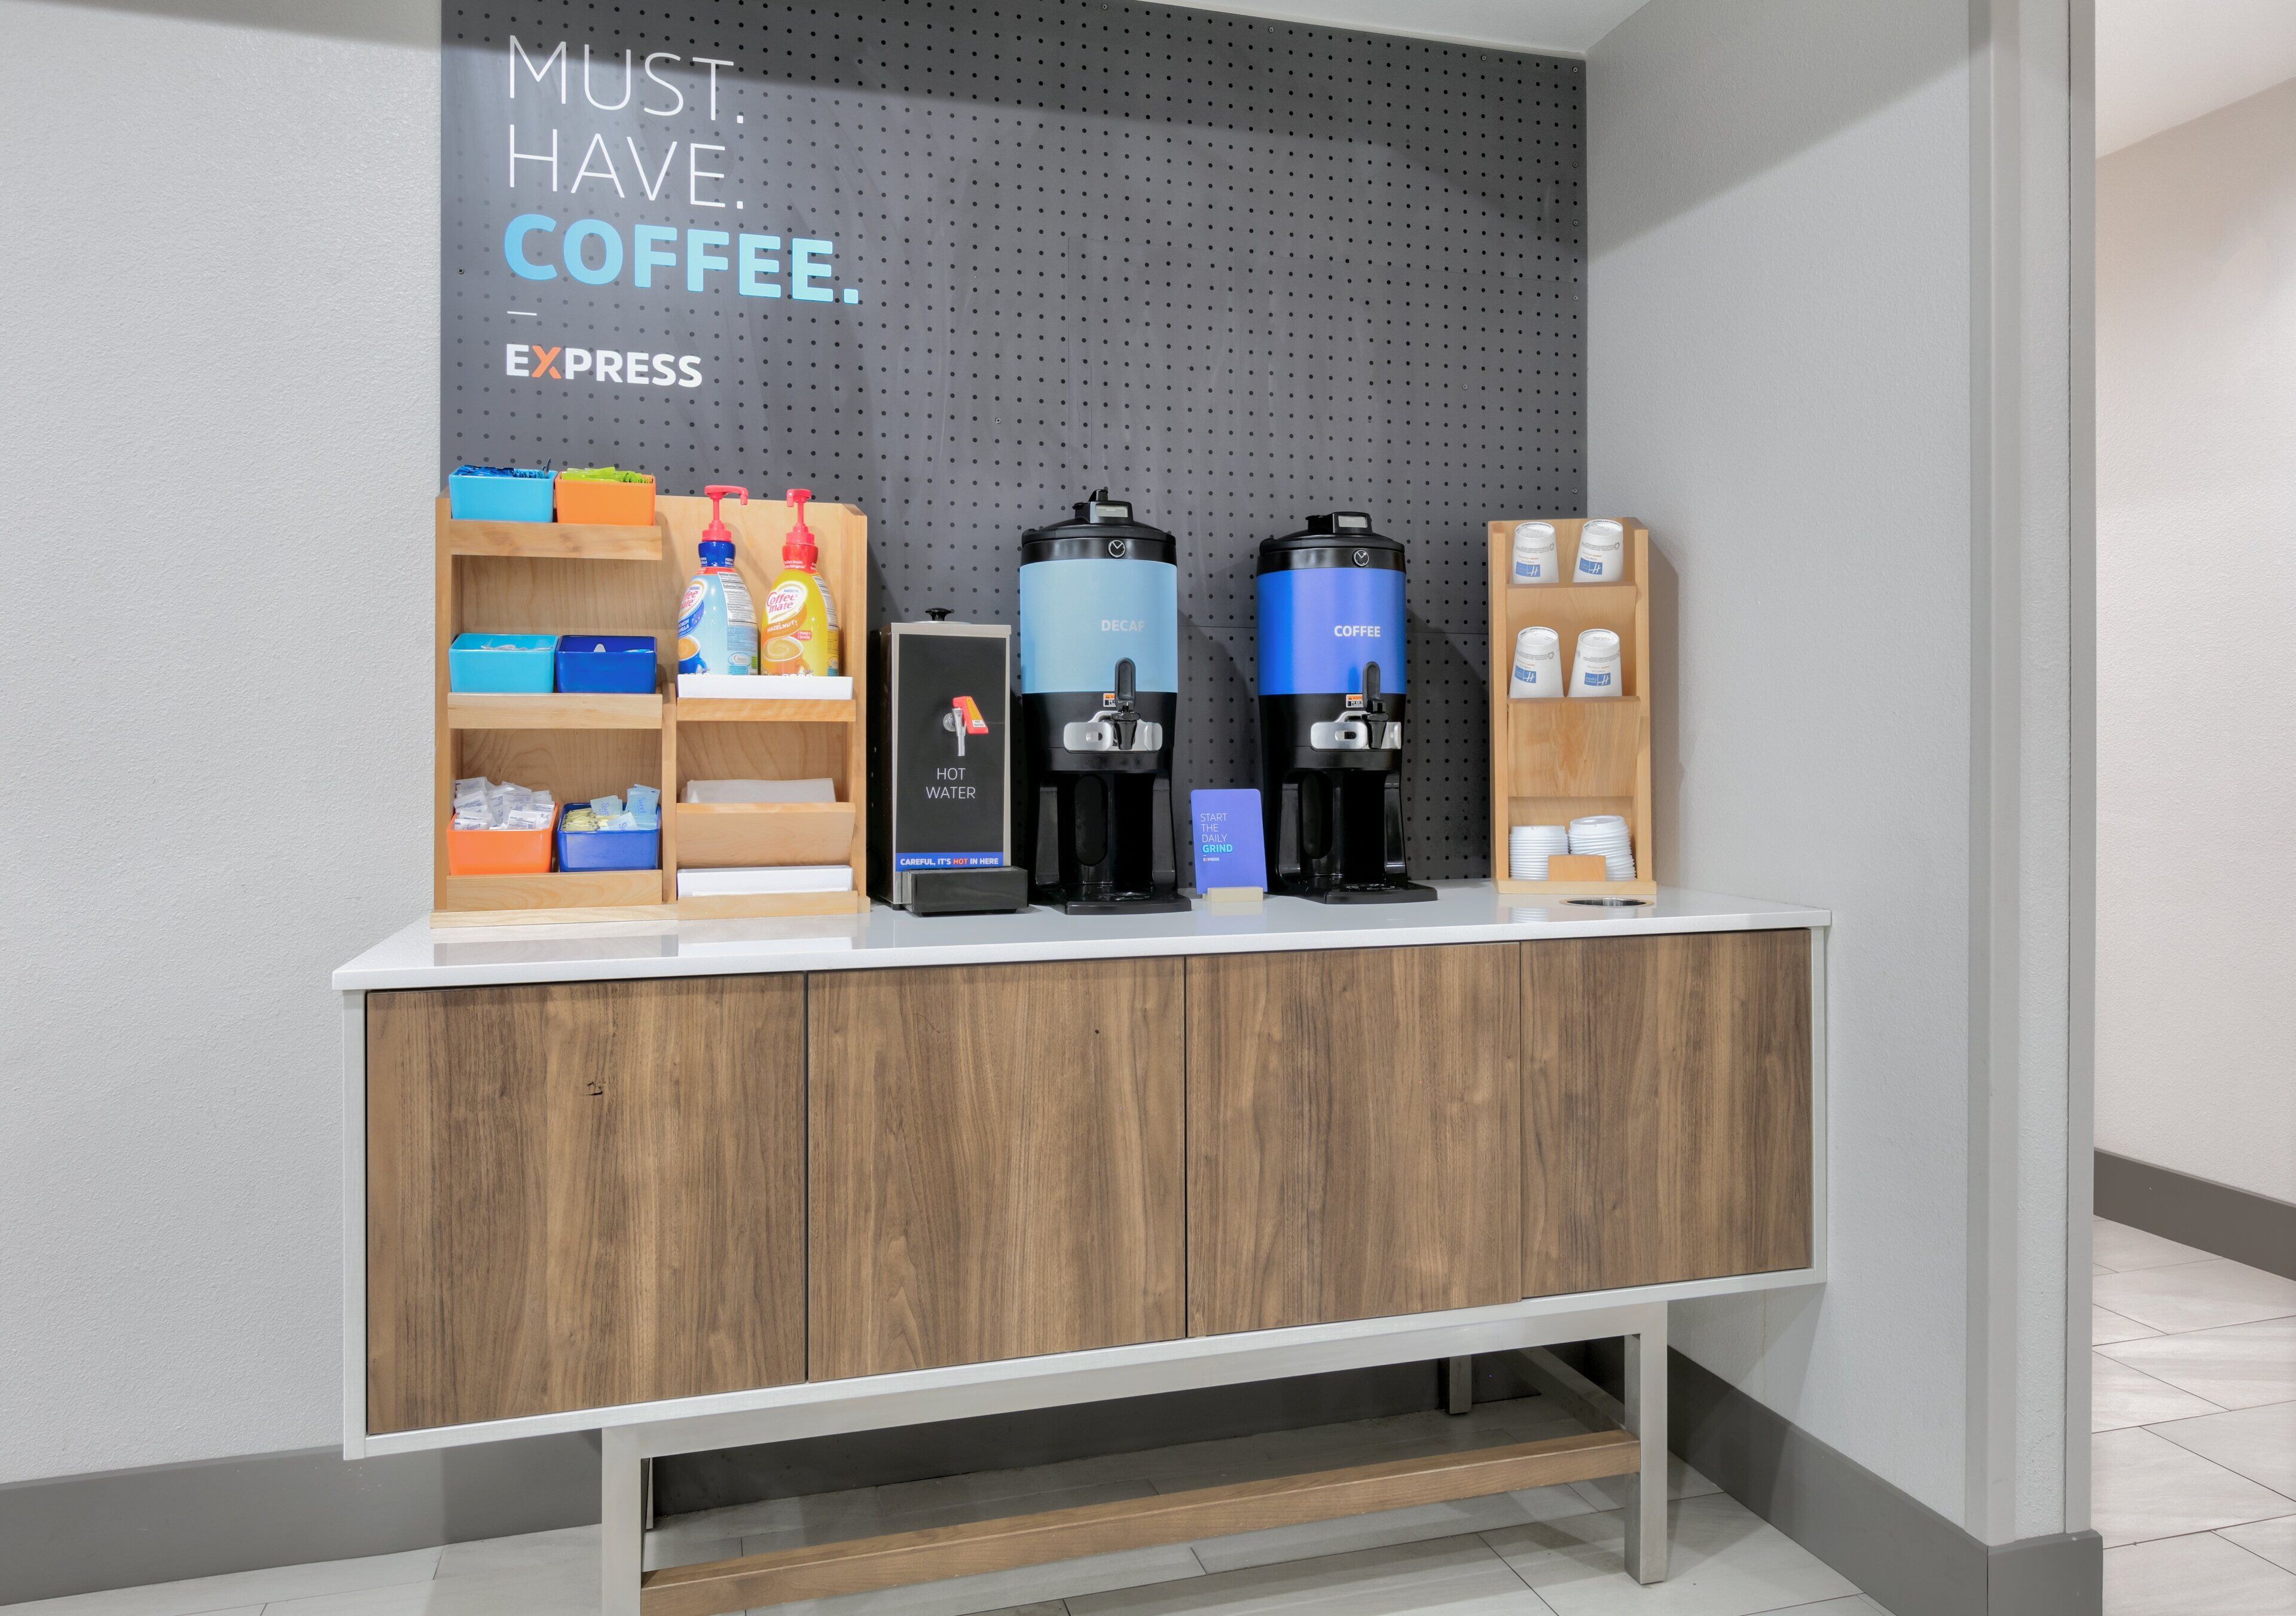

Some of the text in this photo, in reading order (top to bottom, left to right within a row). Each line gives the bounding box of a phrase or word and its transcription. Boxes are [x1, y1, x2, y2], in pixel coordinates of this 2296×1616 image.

[509, 35, 744, 124] MUST.
[509, 124, 744, 209] HAVE.
[503, 213, 859, 304] COFFEE.
[506, 343, 703, 388] EXPRESS
[1101, 619, 1146, 632] DECAF
[1334, 625, 1381, 637] COFFEE
[936, 768, 966, 780] HOT
[926, 786, 976, 799] WATER
[1200, 812, 1228, 822] START
[1201, 823, 1219, 833] THE
[1202, 833, 1228, 843] DAILY
[1202, 844, 1234, 854] GRIND
